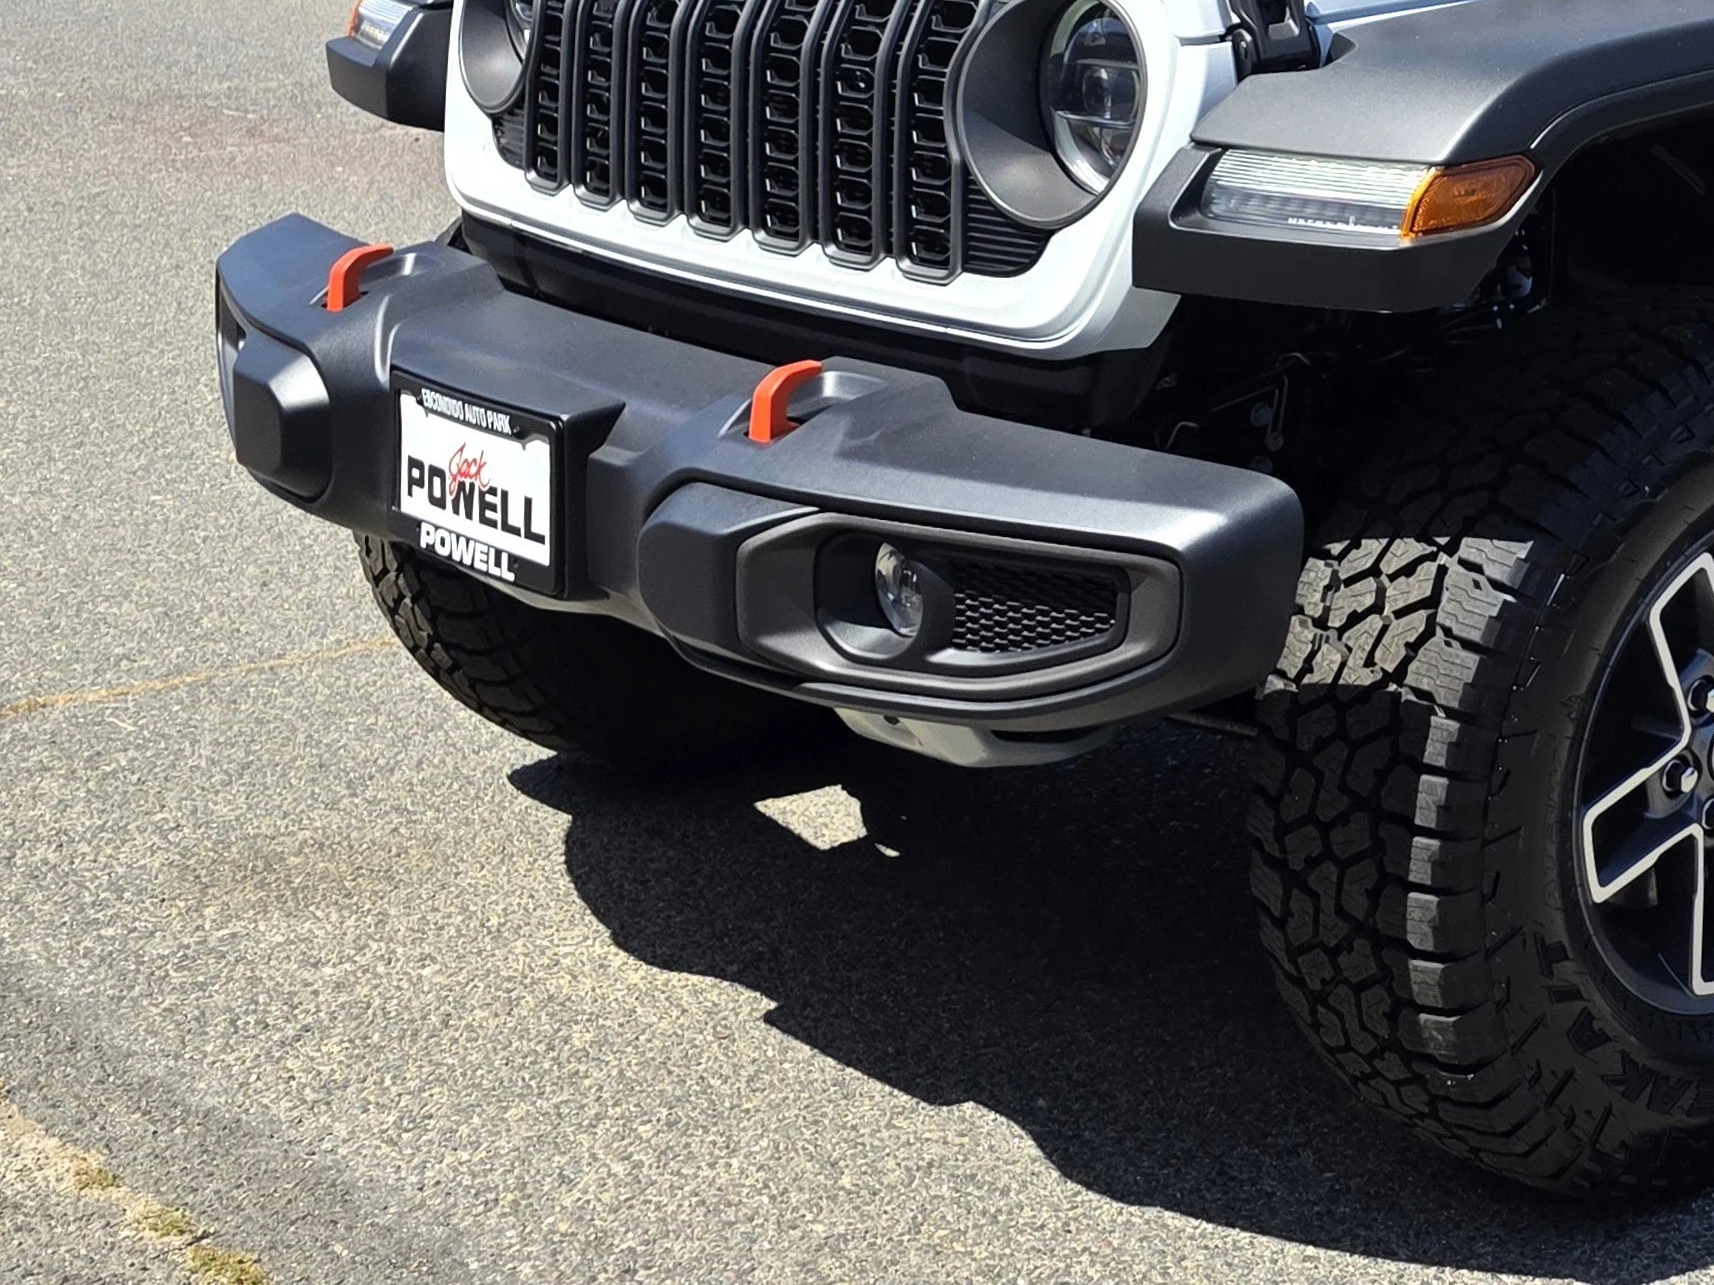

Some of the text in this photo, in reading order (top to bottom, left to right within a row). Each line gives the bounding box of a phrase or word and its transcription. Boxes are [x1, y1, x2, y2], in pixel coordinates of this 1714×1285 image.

[464, 403, 488, 428] AUTO
[487, 410, 512, 435] PARK
[448, 442, 491, 495] Jack
[407, 455, 546, 545] POWELL
[419, 521, 516, 583] POWELL
